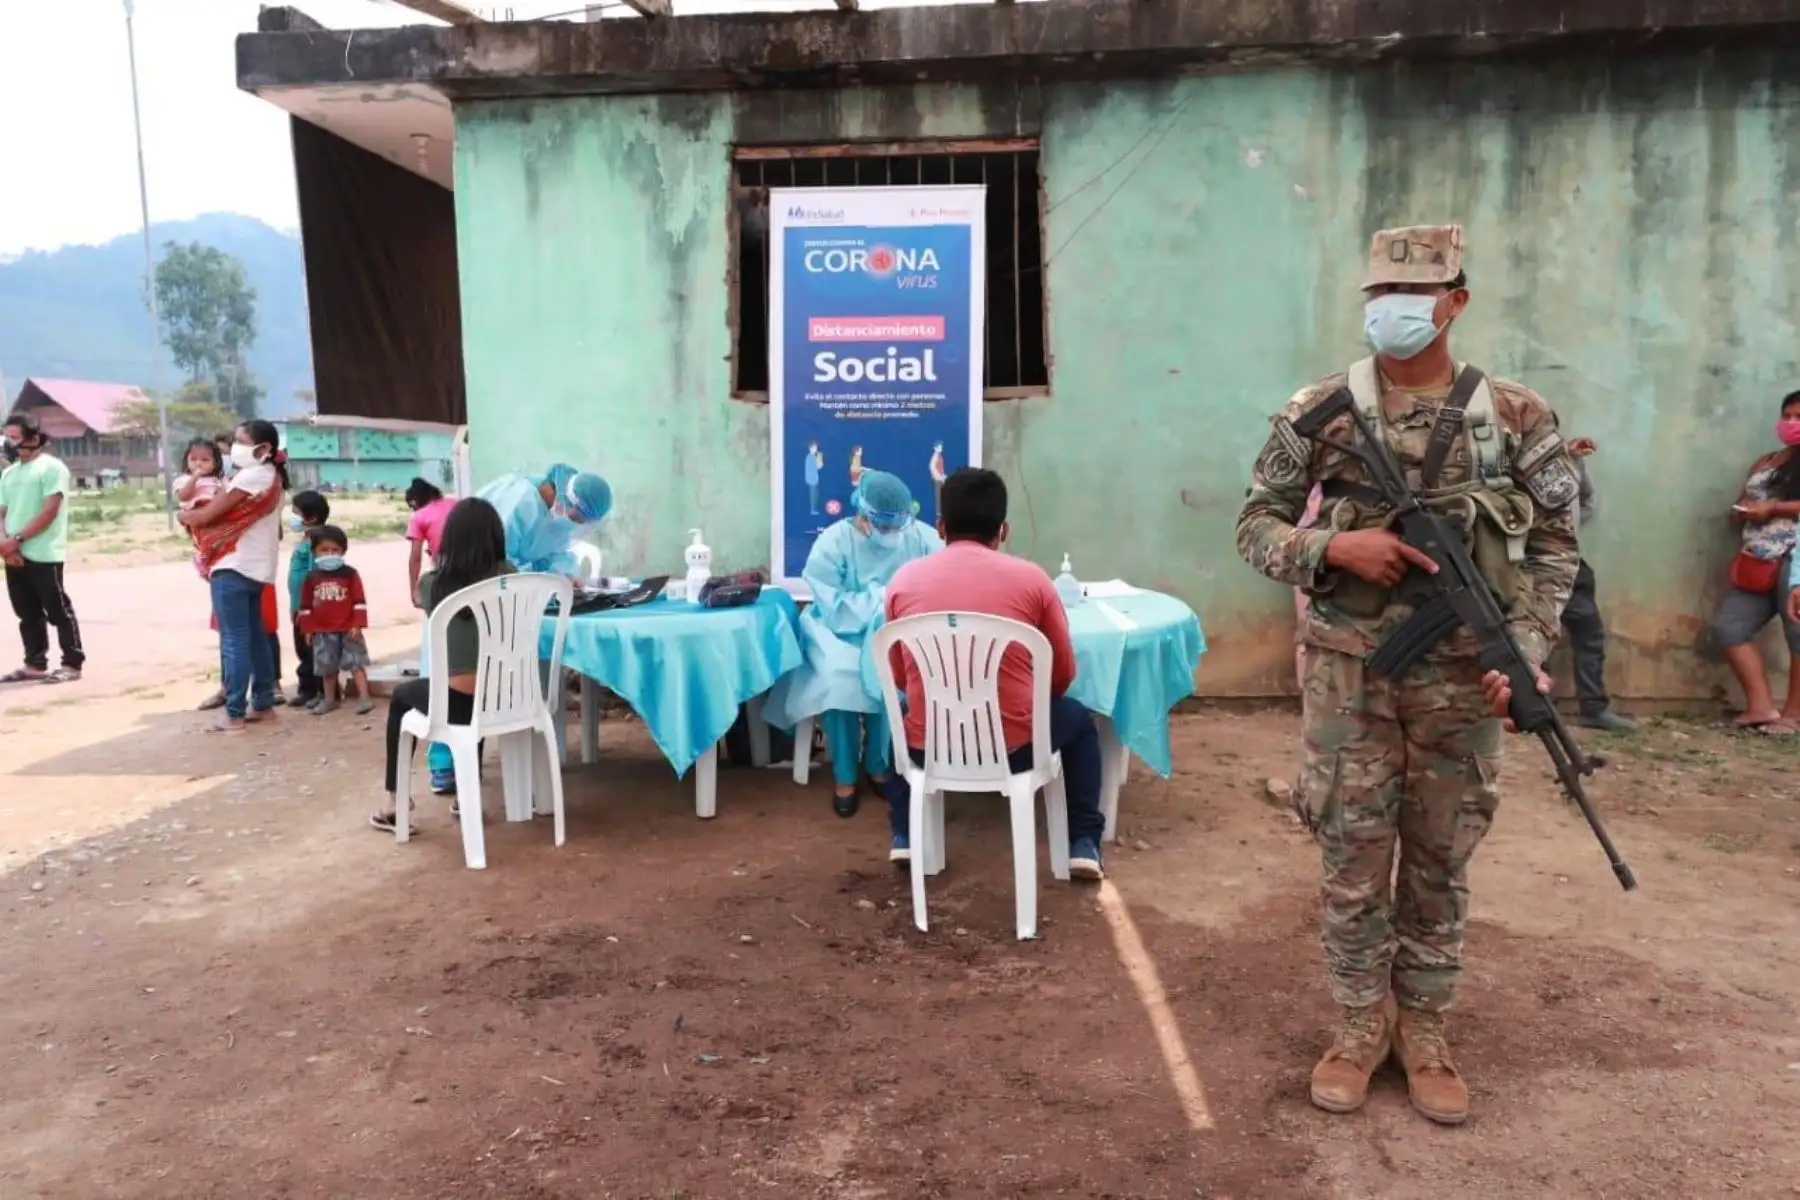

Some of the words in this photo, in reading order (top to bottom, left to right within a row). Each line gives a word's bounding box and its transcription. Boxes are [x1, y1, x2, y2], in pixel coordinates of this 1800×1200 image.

[804, 247, 940, 273] CORONA
[813, 322, 936, 337] Distanciamiento
[813, 346, 938, 382] Social
[947, 613, 957, 627] E
